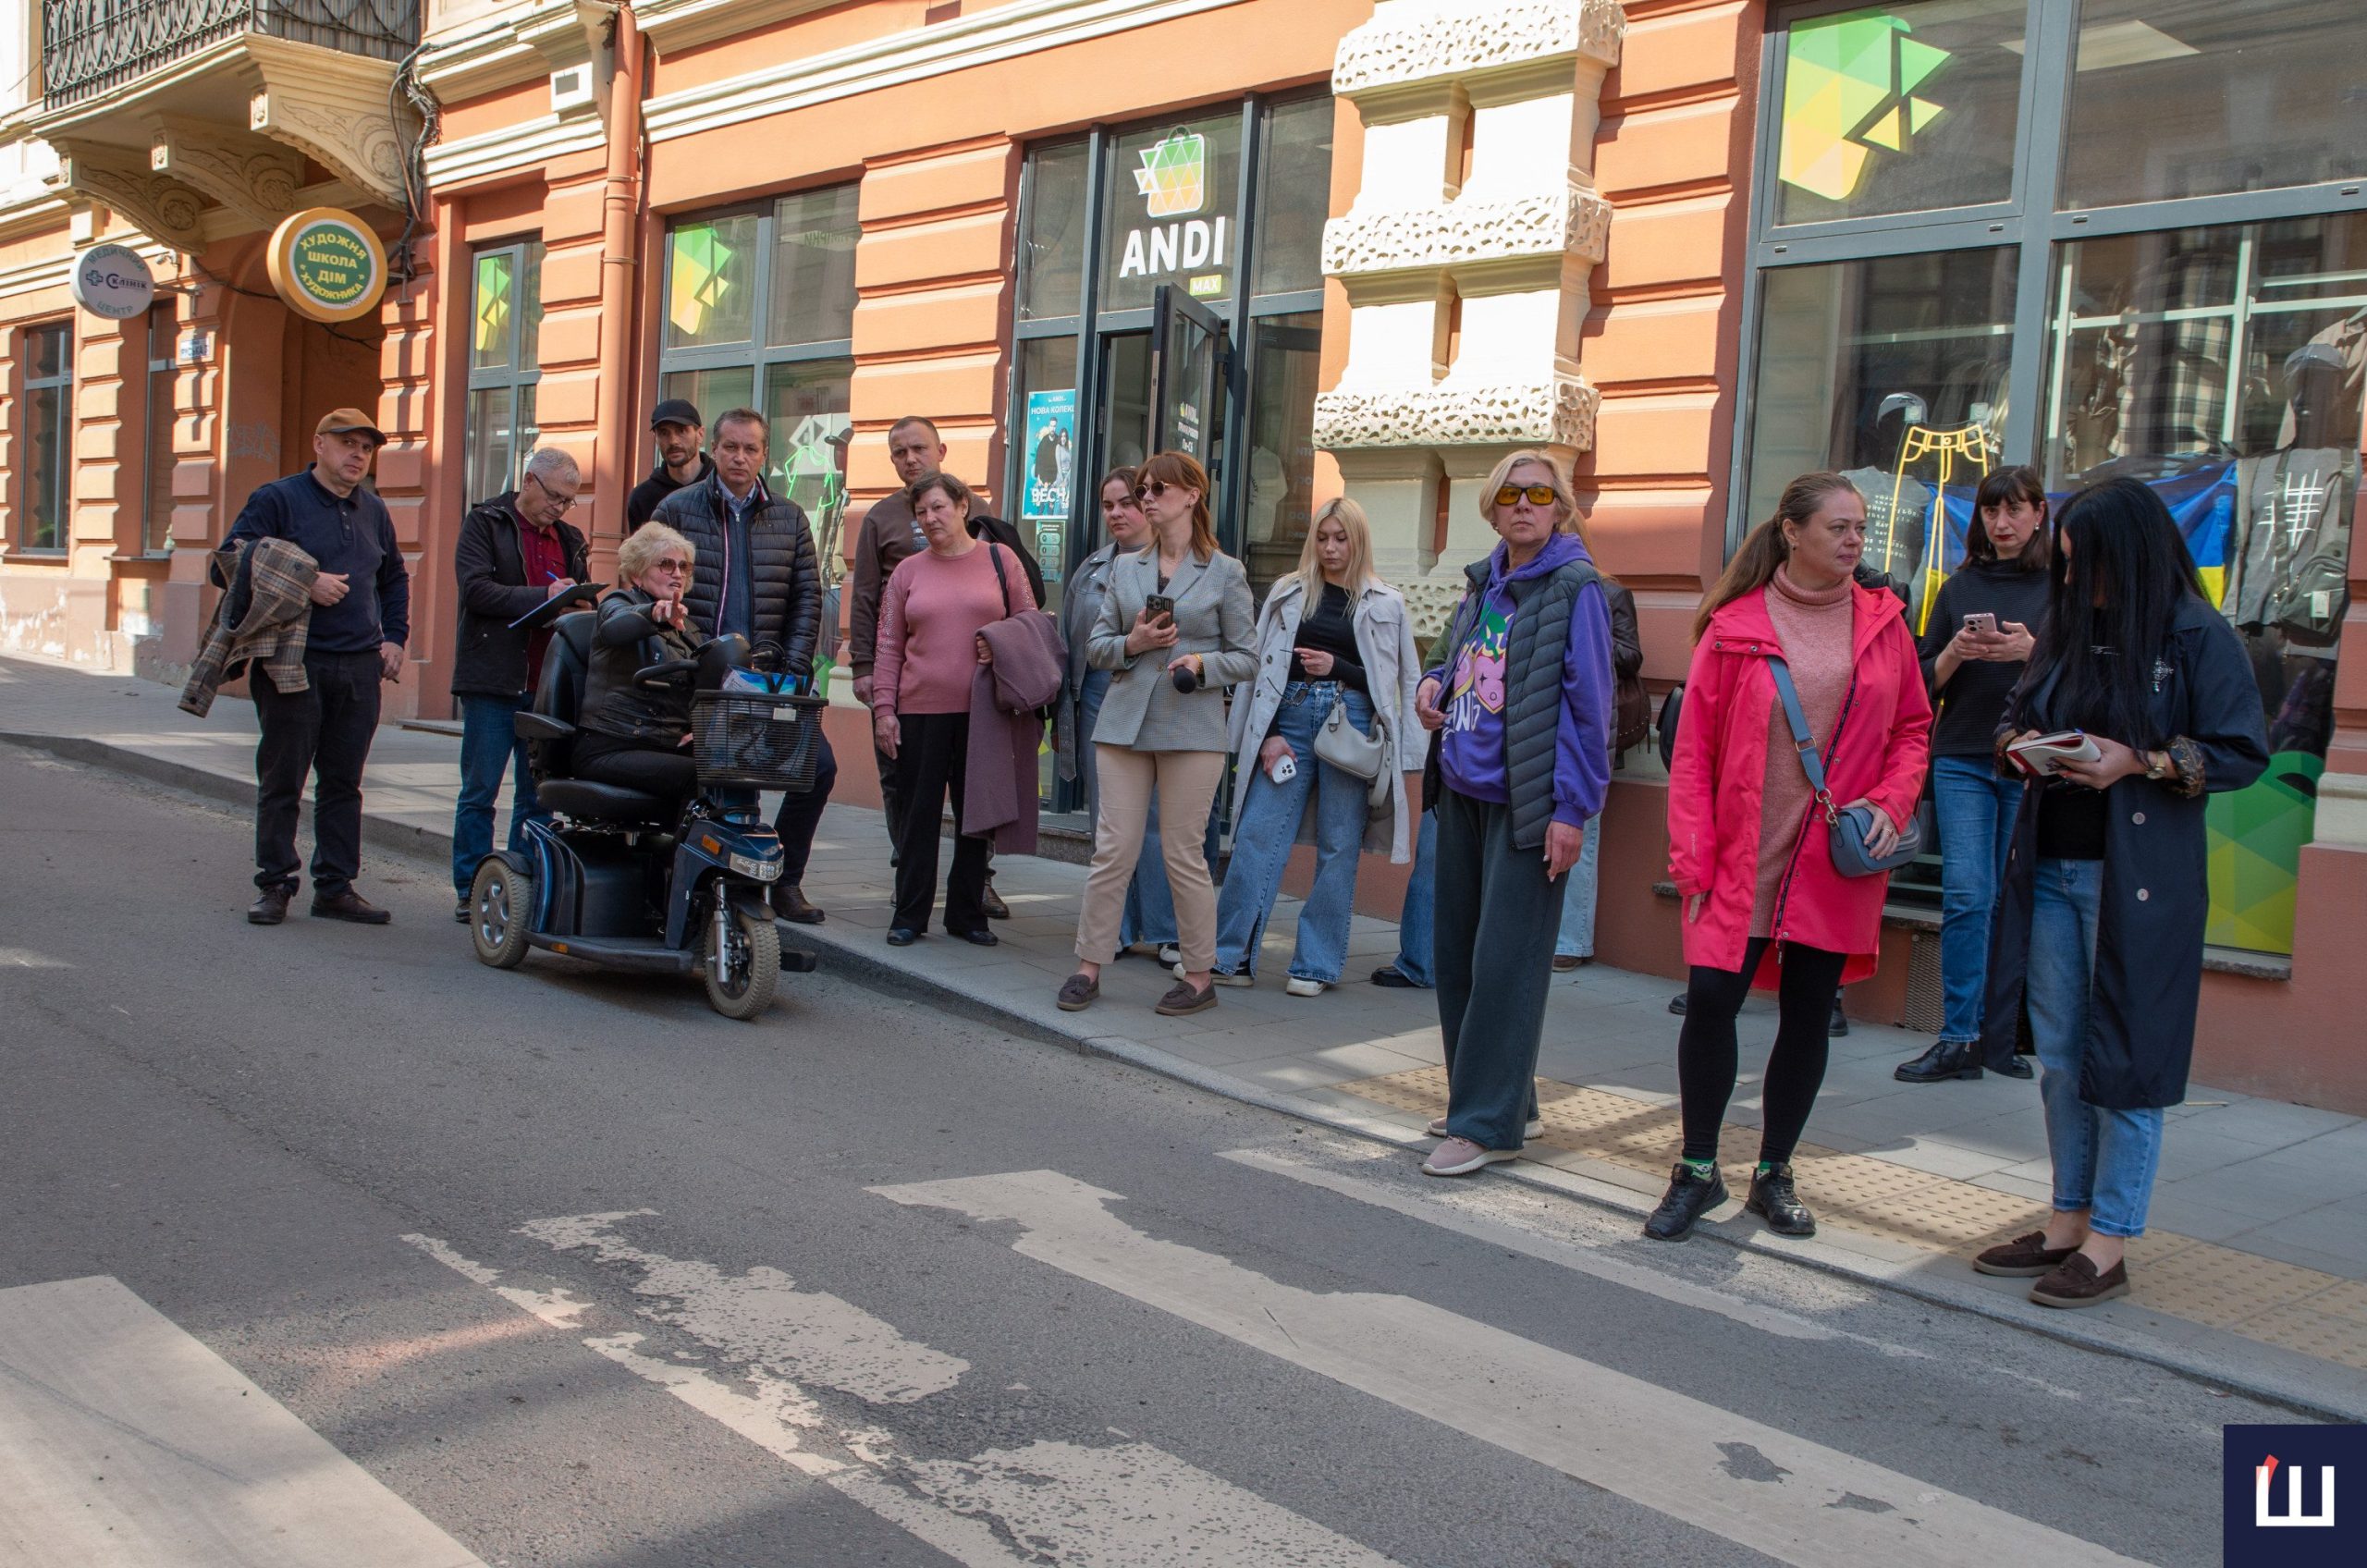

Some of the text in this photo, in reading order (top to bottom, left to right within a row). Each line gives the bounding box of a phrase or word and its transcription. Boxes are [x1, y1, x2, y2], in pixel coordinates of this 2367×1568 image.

[300, 233, 368, 260] ХУДОЖНЯ
[1119, 215, 1226, 278] ANDI
[307, 251, 359, 269] ШКОЛА
[317, 269, 347, 285] ДІМ
[1193, 278, 1219, 293] MAX
[97, 300, 134, 314] ЦЕНТР
[1030, 407, 1050, 415] НОВА
